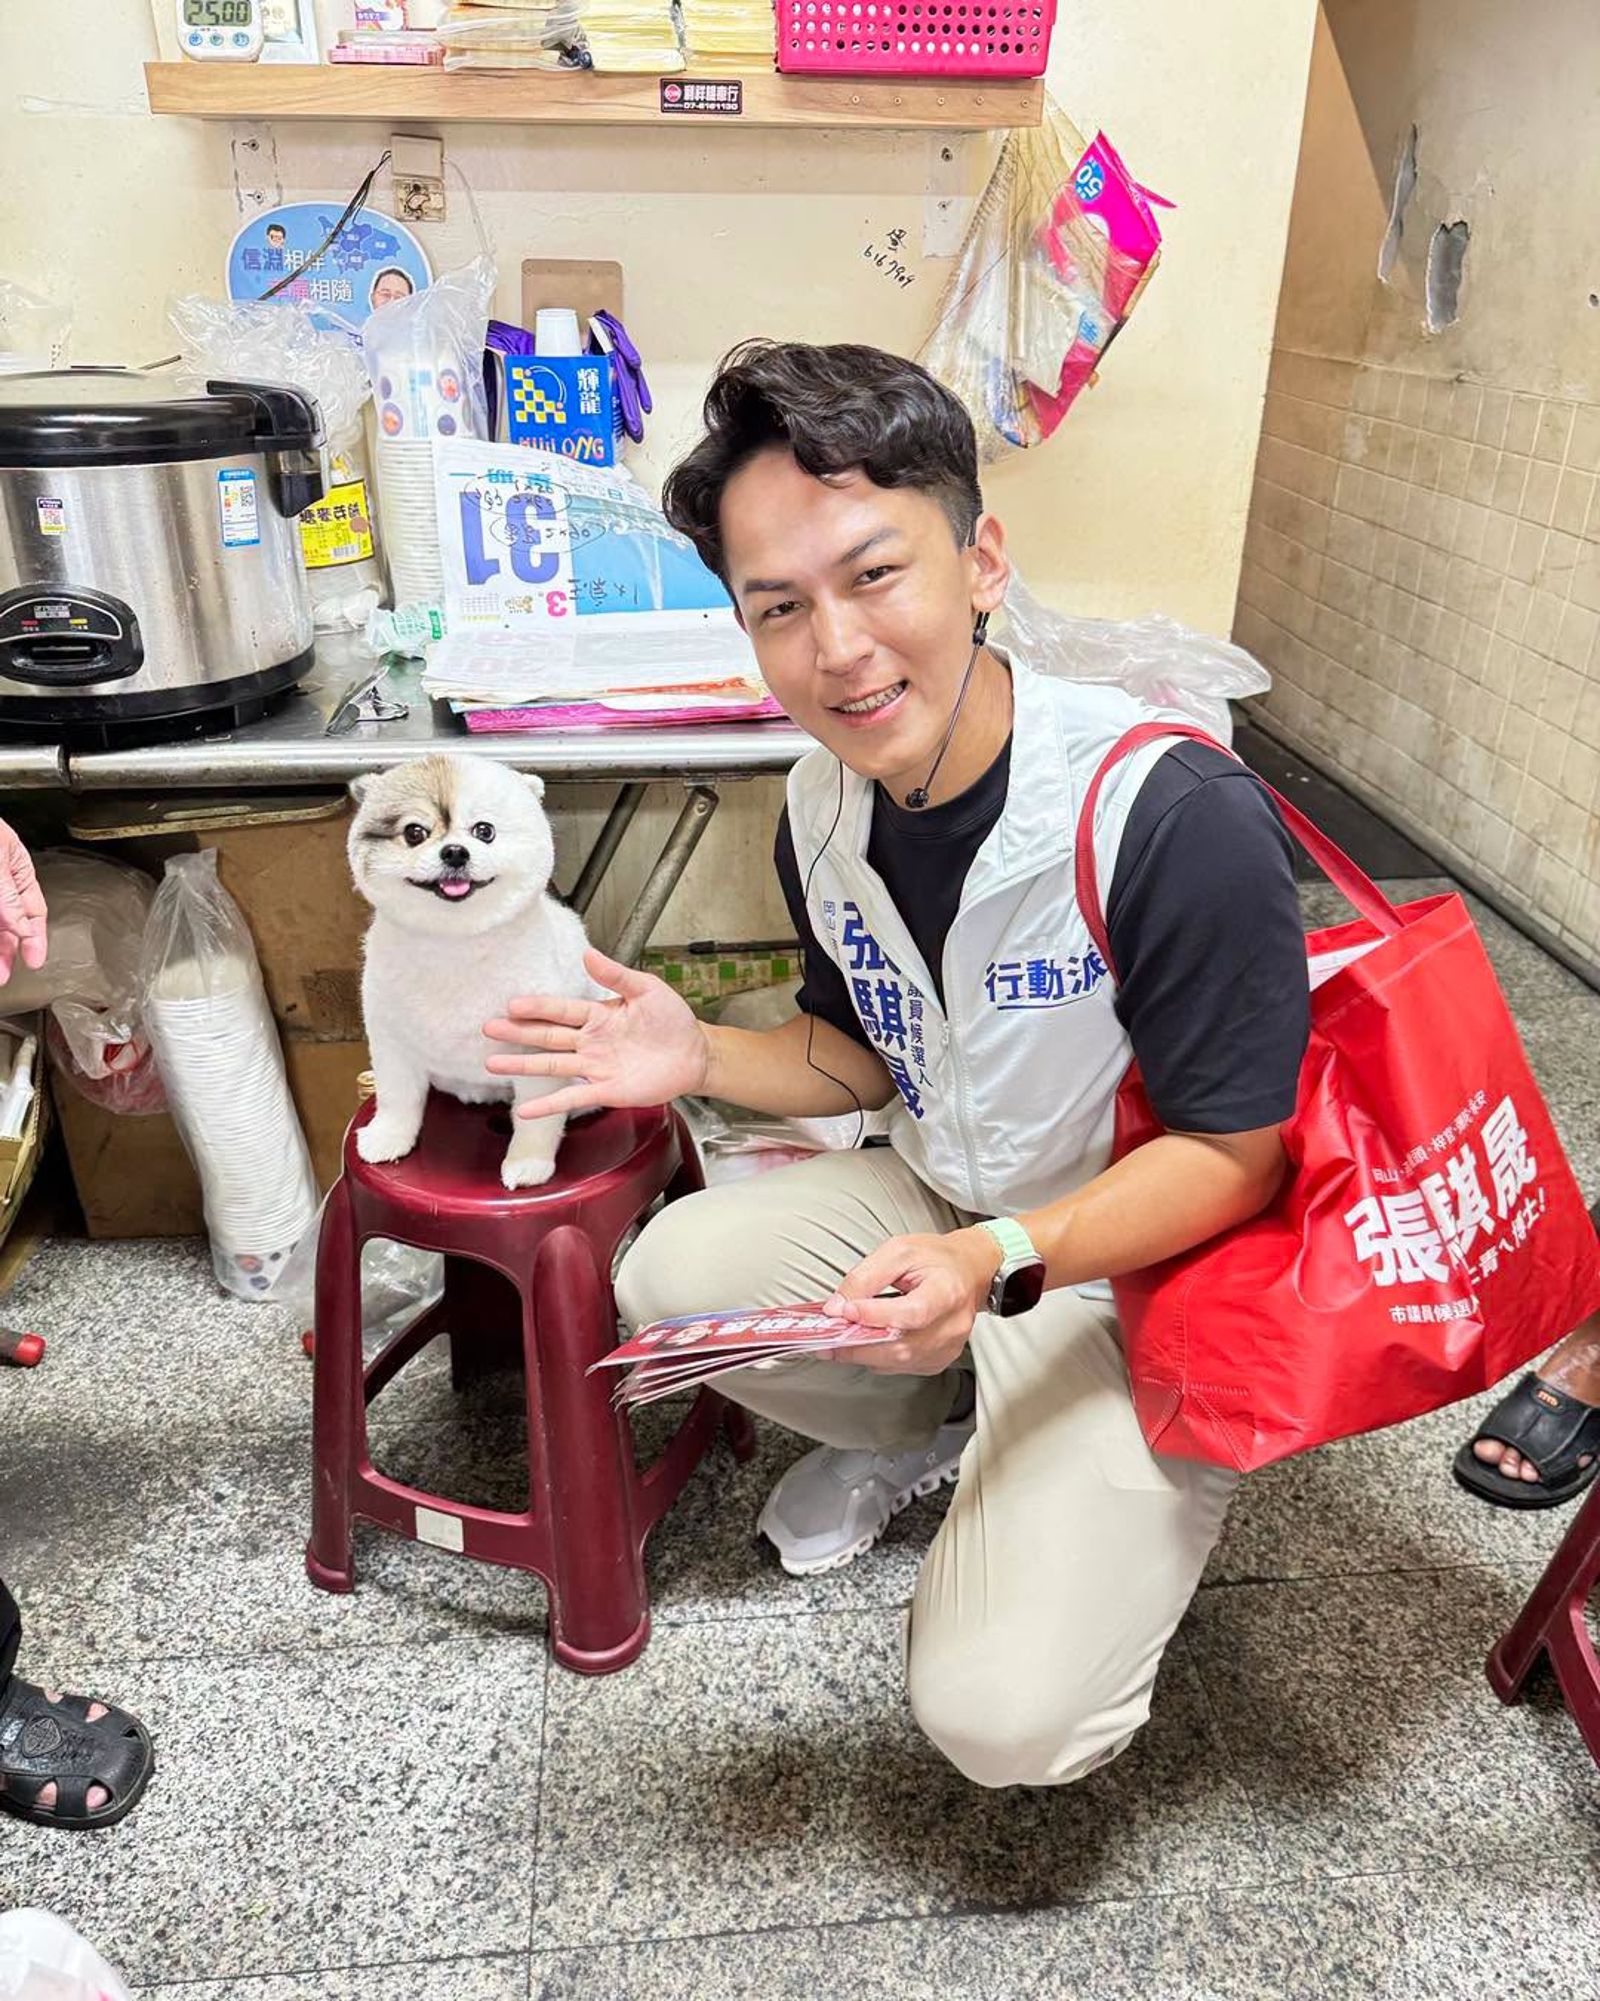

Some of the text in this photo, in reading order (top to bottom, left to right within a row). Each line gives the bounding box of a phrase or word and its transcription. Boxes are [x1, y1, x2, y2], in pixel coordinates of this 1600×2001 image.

[577, 367, 602, 414] 輝龍
[459, 491, 561, 585] 31
[546, 590, 568, 617] 3
[984, 944, 1108, 1003] 行動派
